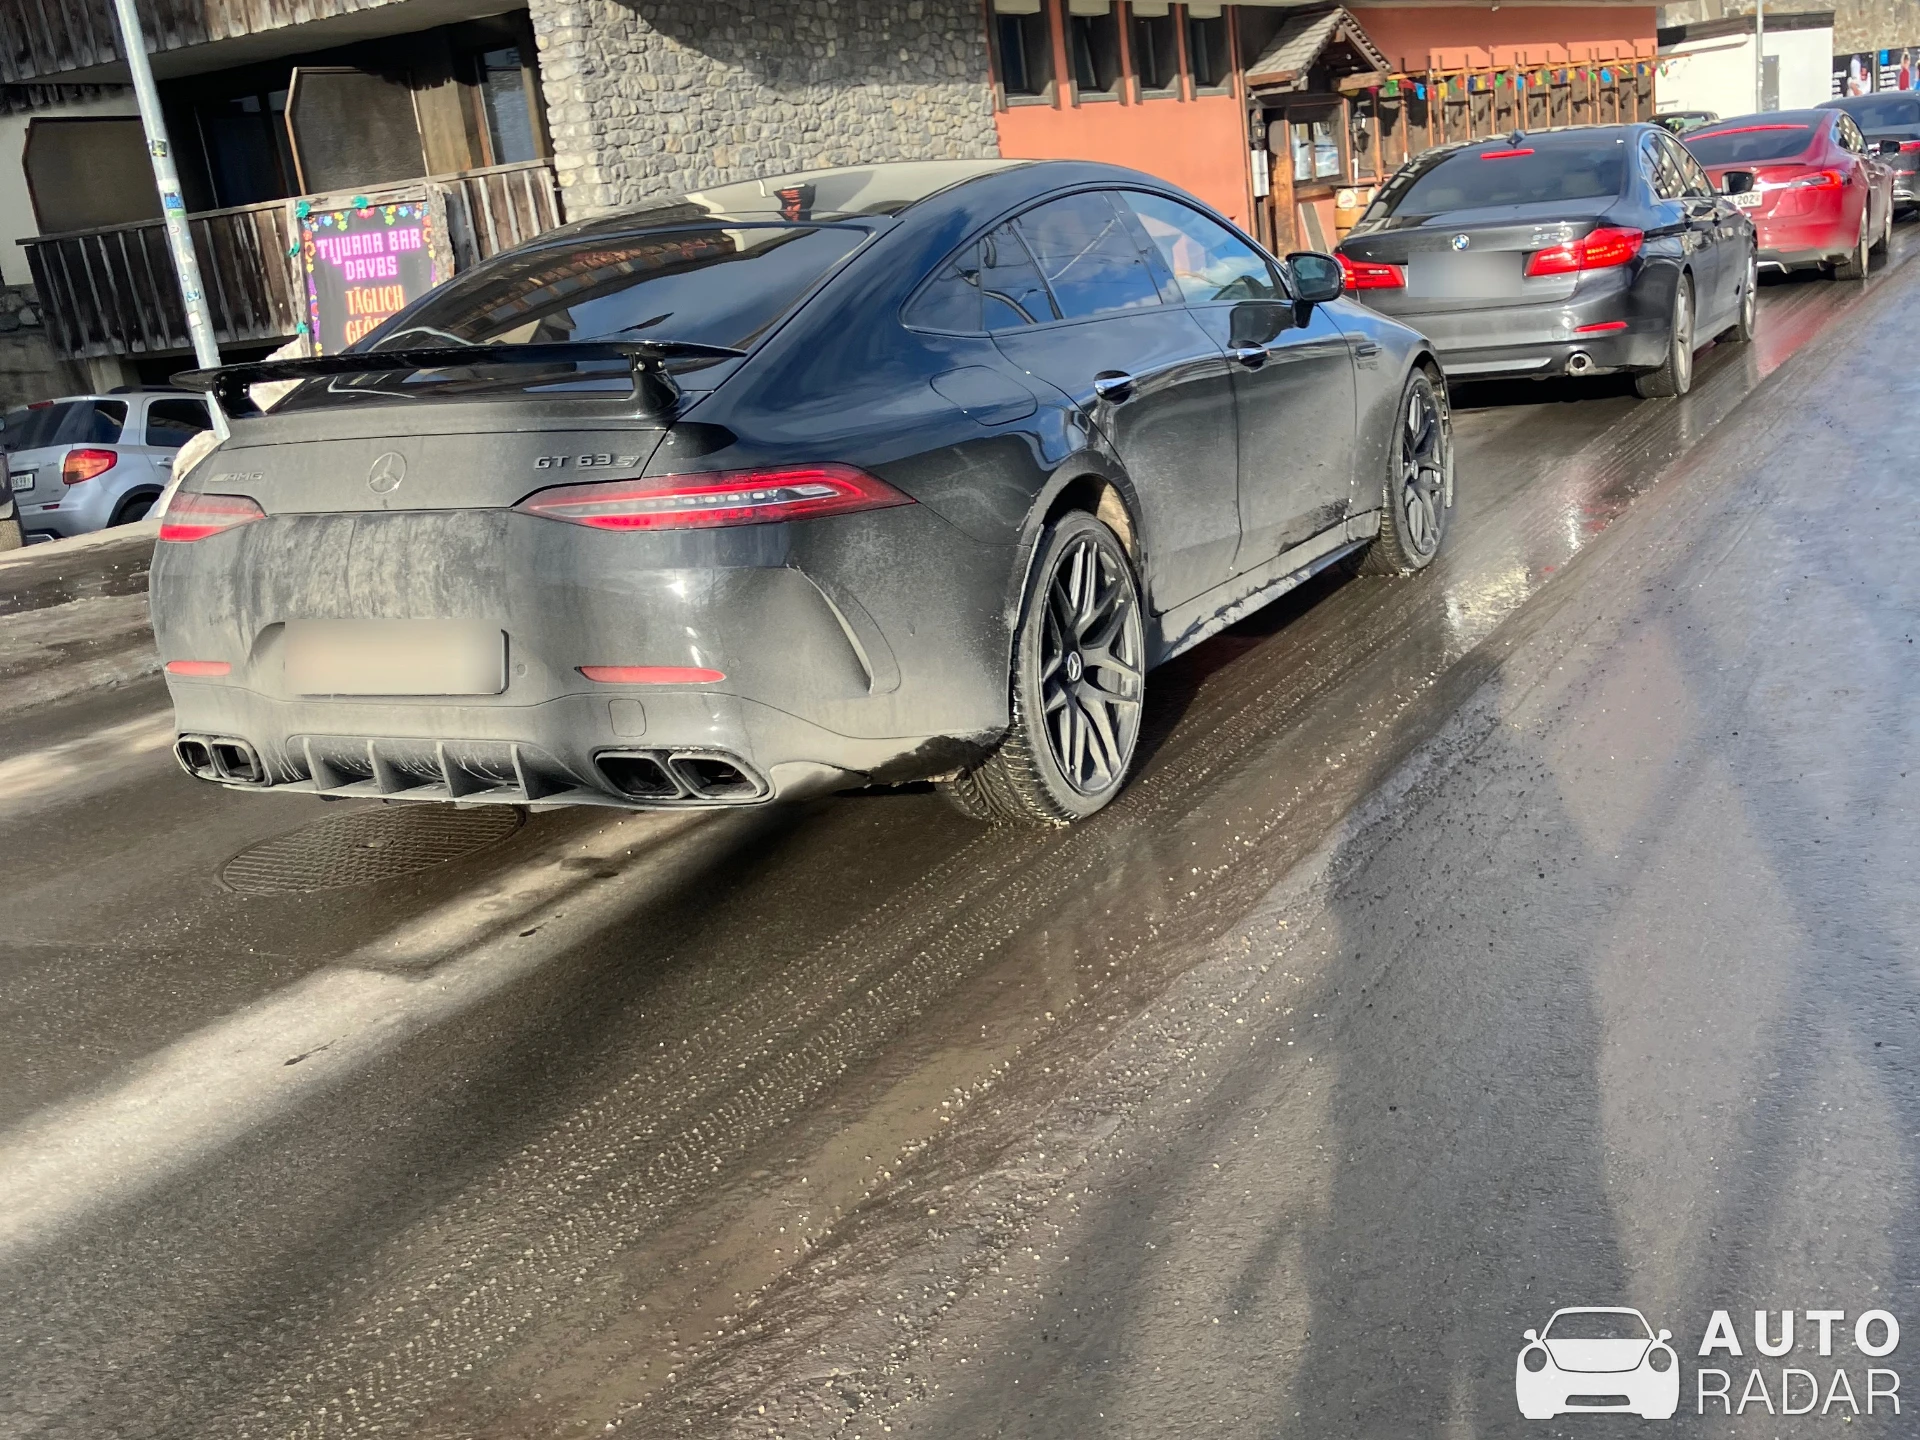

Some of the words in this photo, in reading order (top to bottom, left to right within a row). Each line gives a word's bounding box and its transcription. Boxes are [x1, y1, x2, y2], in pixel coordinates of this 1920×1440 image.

[315, 231, 384, 265] TIJUANA
[387, 228, 421, 251] BAR
[344, 284, 405, 315] TÄGLICH
[345, 315, 389, 346] GEÖ
[225, 471, 264, 481] AMG
[535, 456, 570, 469] GT
